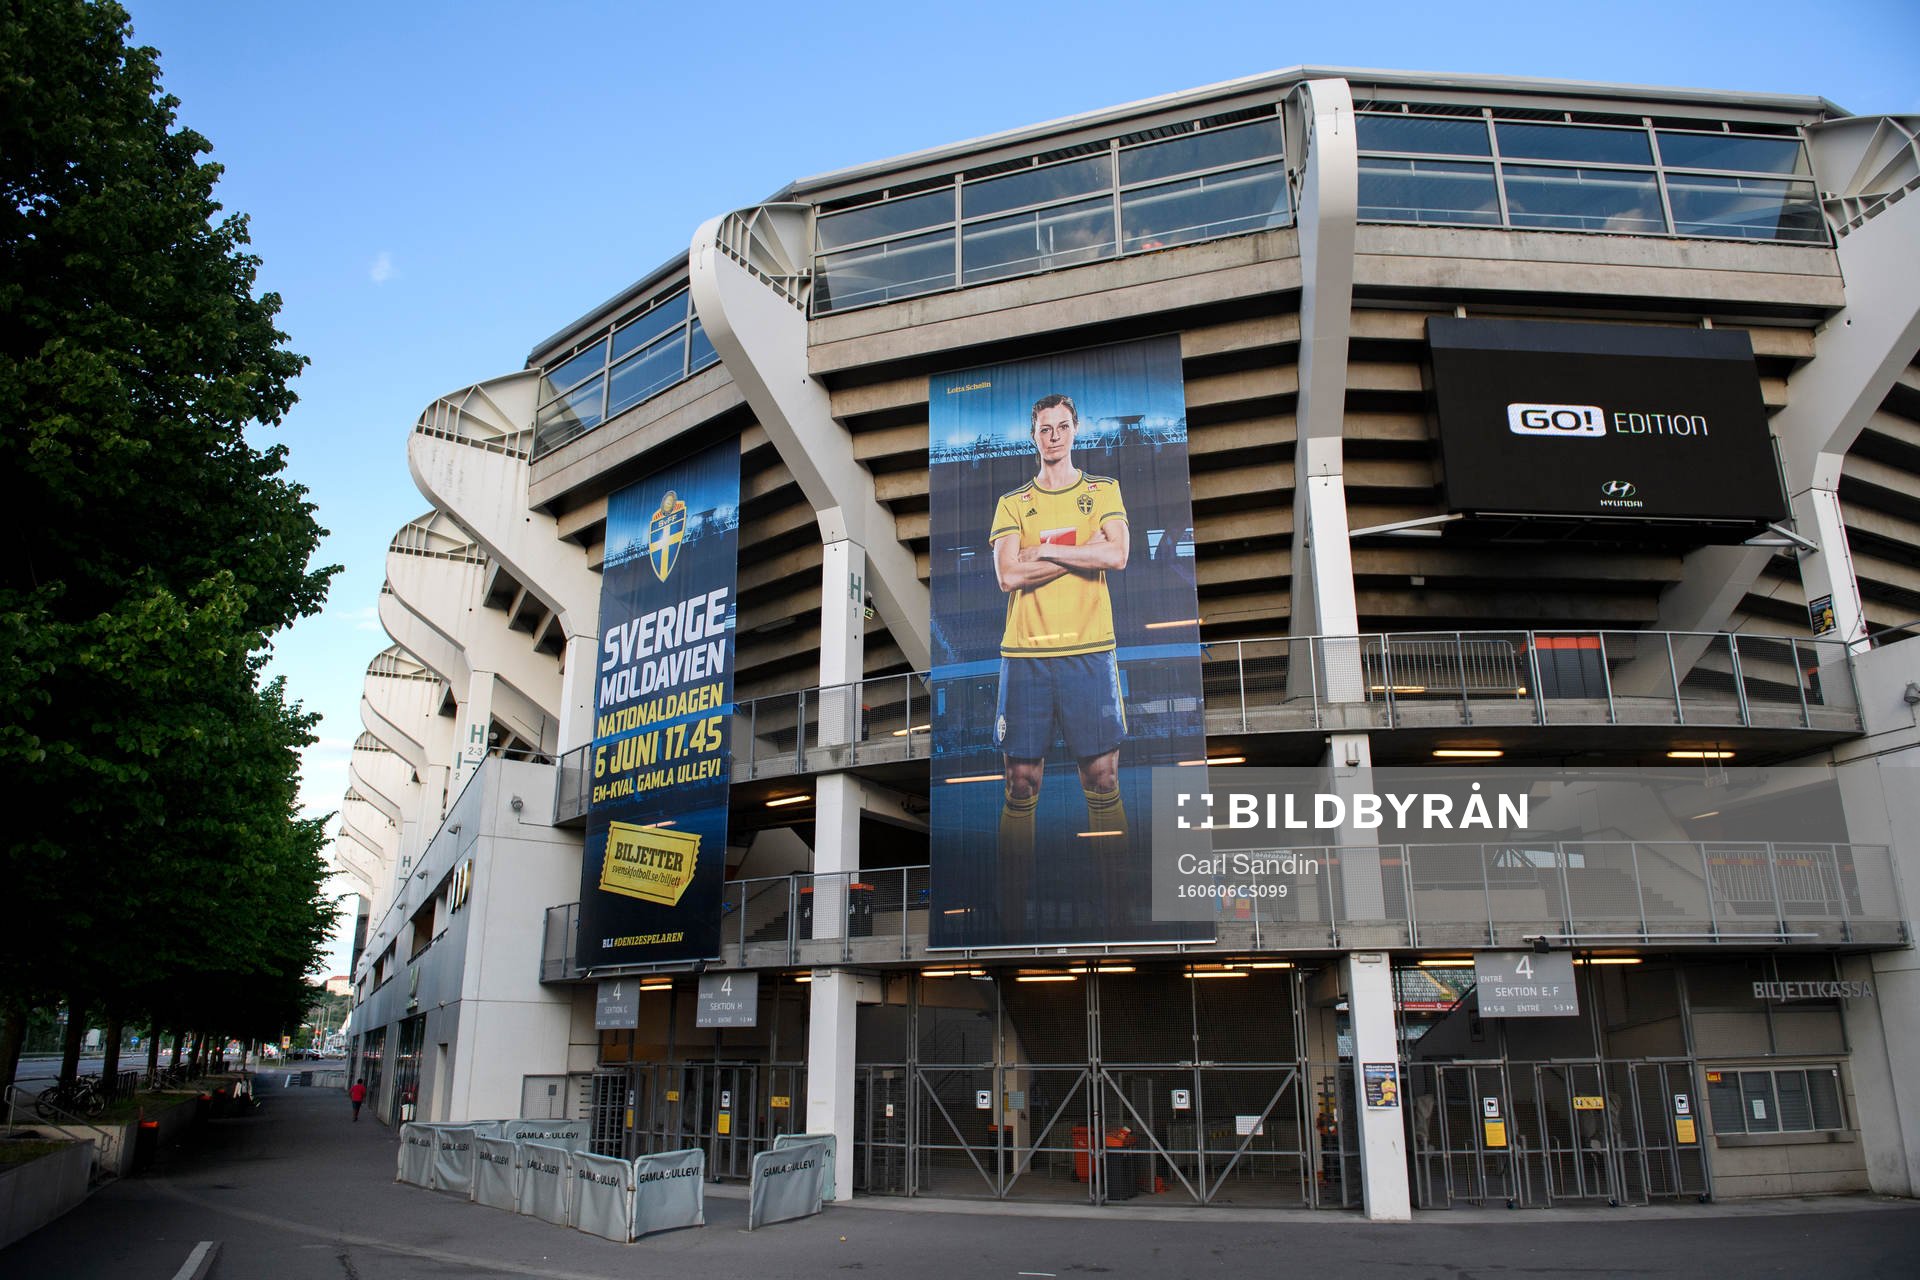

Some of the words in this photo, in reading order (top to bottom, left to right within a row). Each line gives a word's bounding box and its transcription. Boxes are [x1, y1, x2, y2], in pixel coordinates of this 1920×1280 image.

[947, 385, 965, 394] Lotta
[966, 381, 992, 391] Schelin
[1521, 410, 1594, 431] GO!
[1614, 412, 1709, 436] EDITION
[1600, 499, 1643, 508] HYUNDAI
[850, 572, 862, 604] H
[602, 587, 728, 671] SVERIGE
[600, 639, 726, 709] MOLDAVIEN
[597, 682, 724, 739] NATIONALDAGEN
[470, 724, 485, 744] H
[468, 747, 483, 757] 2-3
[594, 749, 606, 778] 6
[610, 732, 659, 774] JUNI
[665, 715, 723, 761] 17.45
[593, 777, 636, 803] EM-KVAL
[637, 768, 675, 793] GAMLA
[677, 758, 721, 784] ULLEVI
[615, 842, 684, 873] BILJETTER
[602, 938, 614, 949] BLI
[614, 932, 684, 948] #DEN12ESPELAREN
[1515, 955, 1534, 979] 4
[613, 982, 622, 1001] 4
[720, 975, 733, 997] 4
[1495, 987, 1537, 997] SEKTION
[1752, 981, 1873, 1002] BILJETTKASSA
[710, 1002, 735, 1011] SEKTION
[640, 1171, 665, 1183] GAMLA
[671, 1167, 699, 1178] ULLEVI
[764, 1165, 786, 1178] GAMLA
[791, 1160, 815, 1171] ULLEVI
